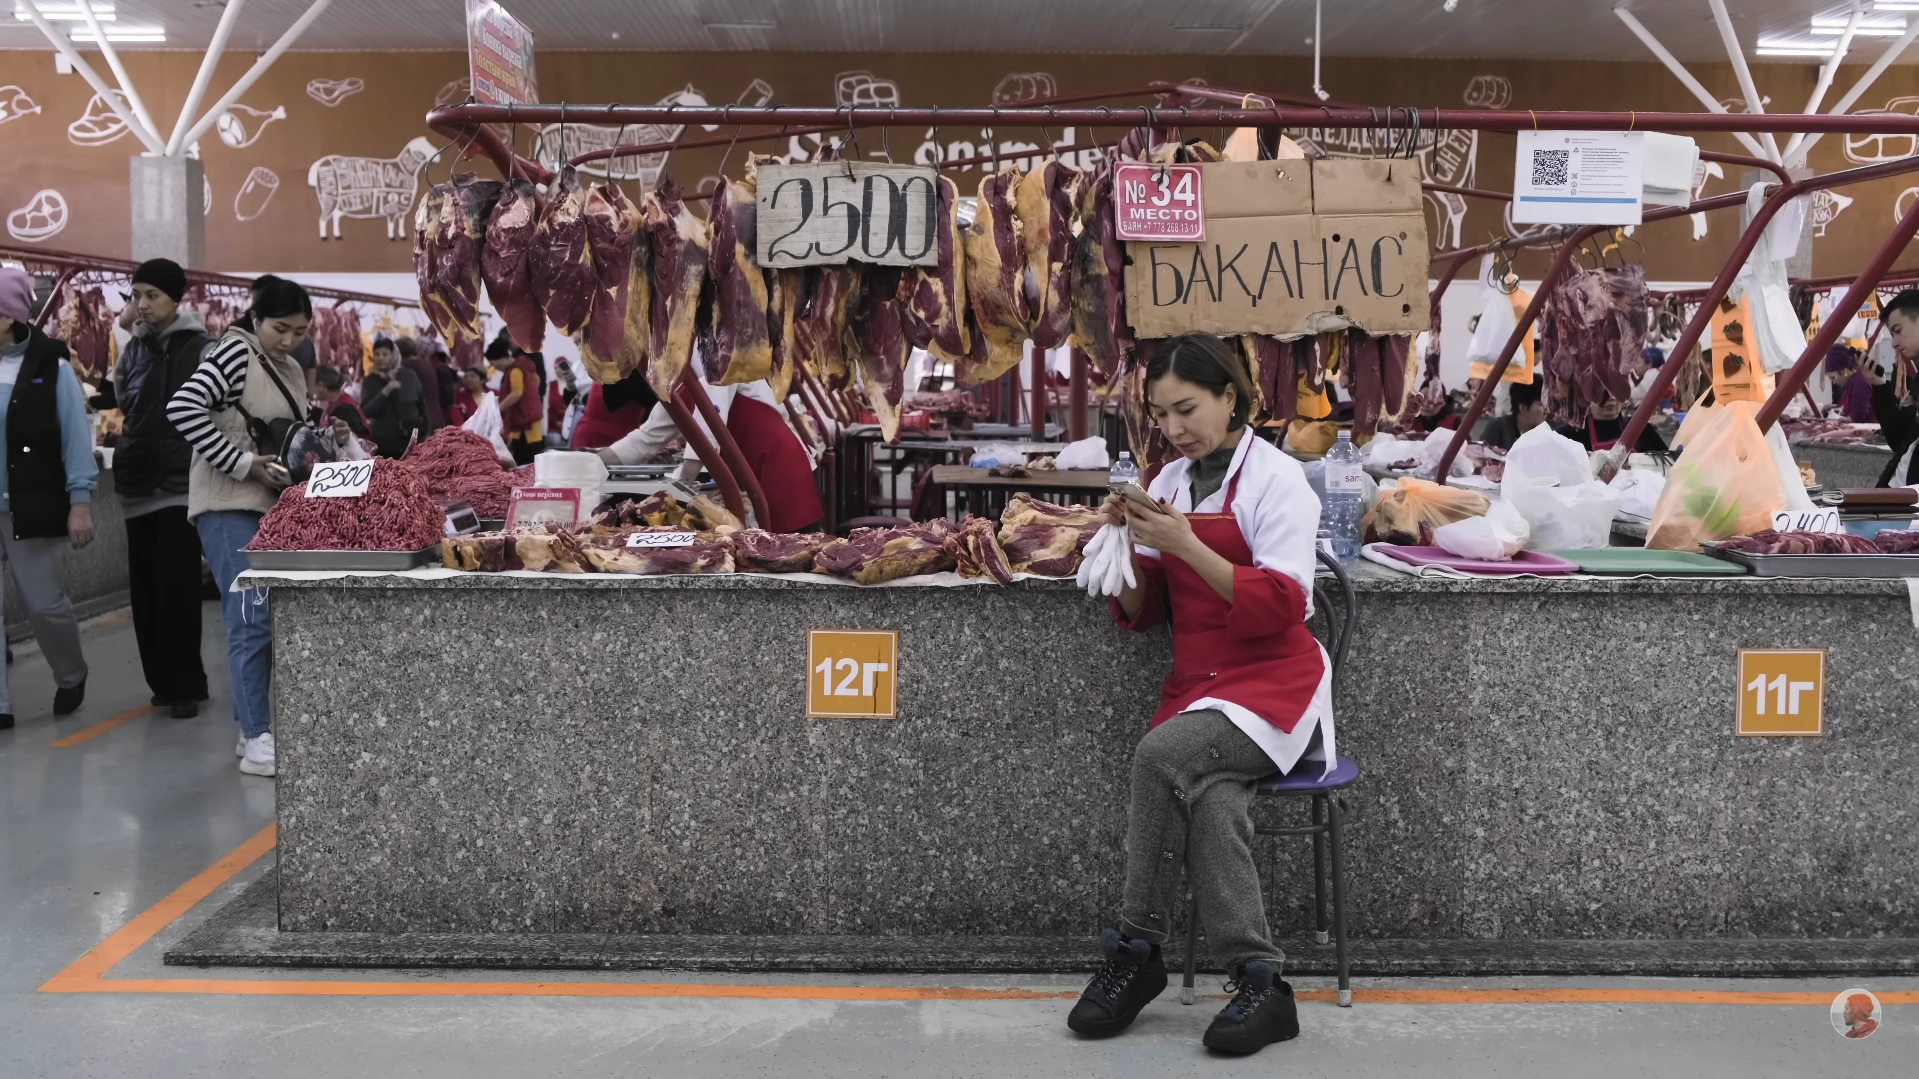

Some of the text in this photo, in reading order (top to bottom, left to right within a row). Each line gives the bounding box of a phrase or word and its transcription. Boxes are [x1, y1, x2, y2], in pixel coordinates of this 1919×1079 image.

[474, 48, 501, 80] Толстый
[1125, 172, 1196, 207] № 34
[768, 174, 937, 262] 2500
[1123, 221, 1142, 231] БАЯН
[1144, 222, 1152, 231] +7
[1167, 222, 1179, 233] 268
[1181, 223, 1189, 233] 13
[1190, 224, 1198, 233] 11
[1130, 208, 1198, 220] МЕСТО
[1150, 236, 1404, 307] БАҚАНАС
[312, 464, 371, 493] 2500
[1776, 512, 1839, 533] 2400
[636, 534, 697, 545] 2500
